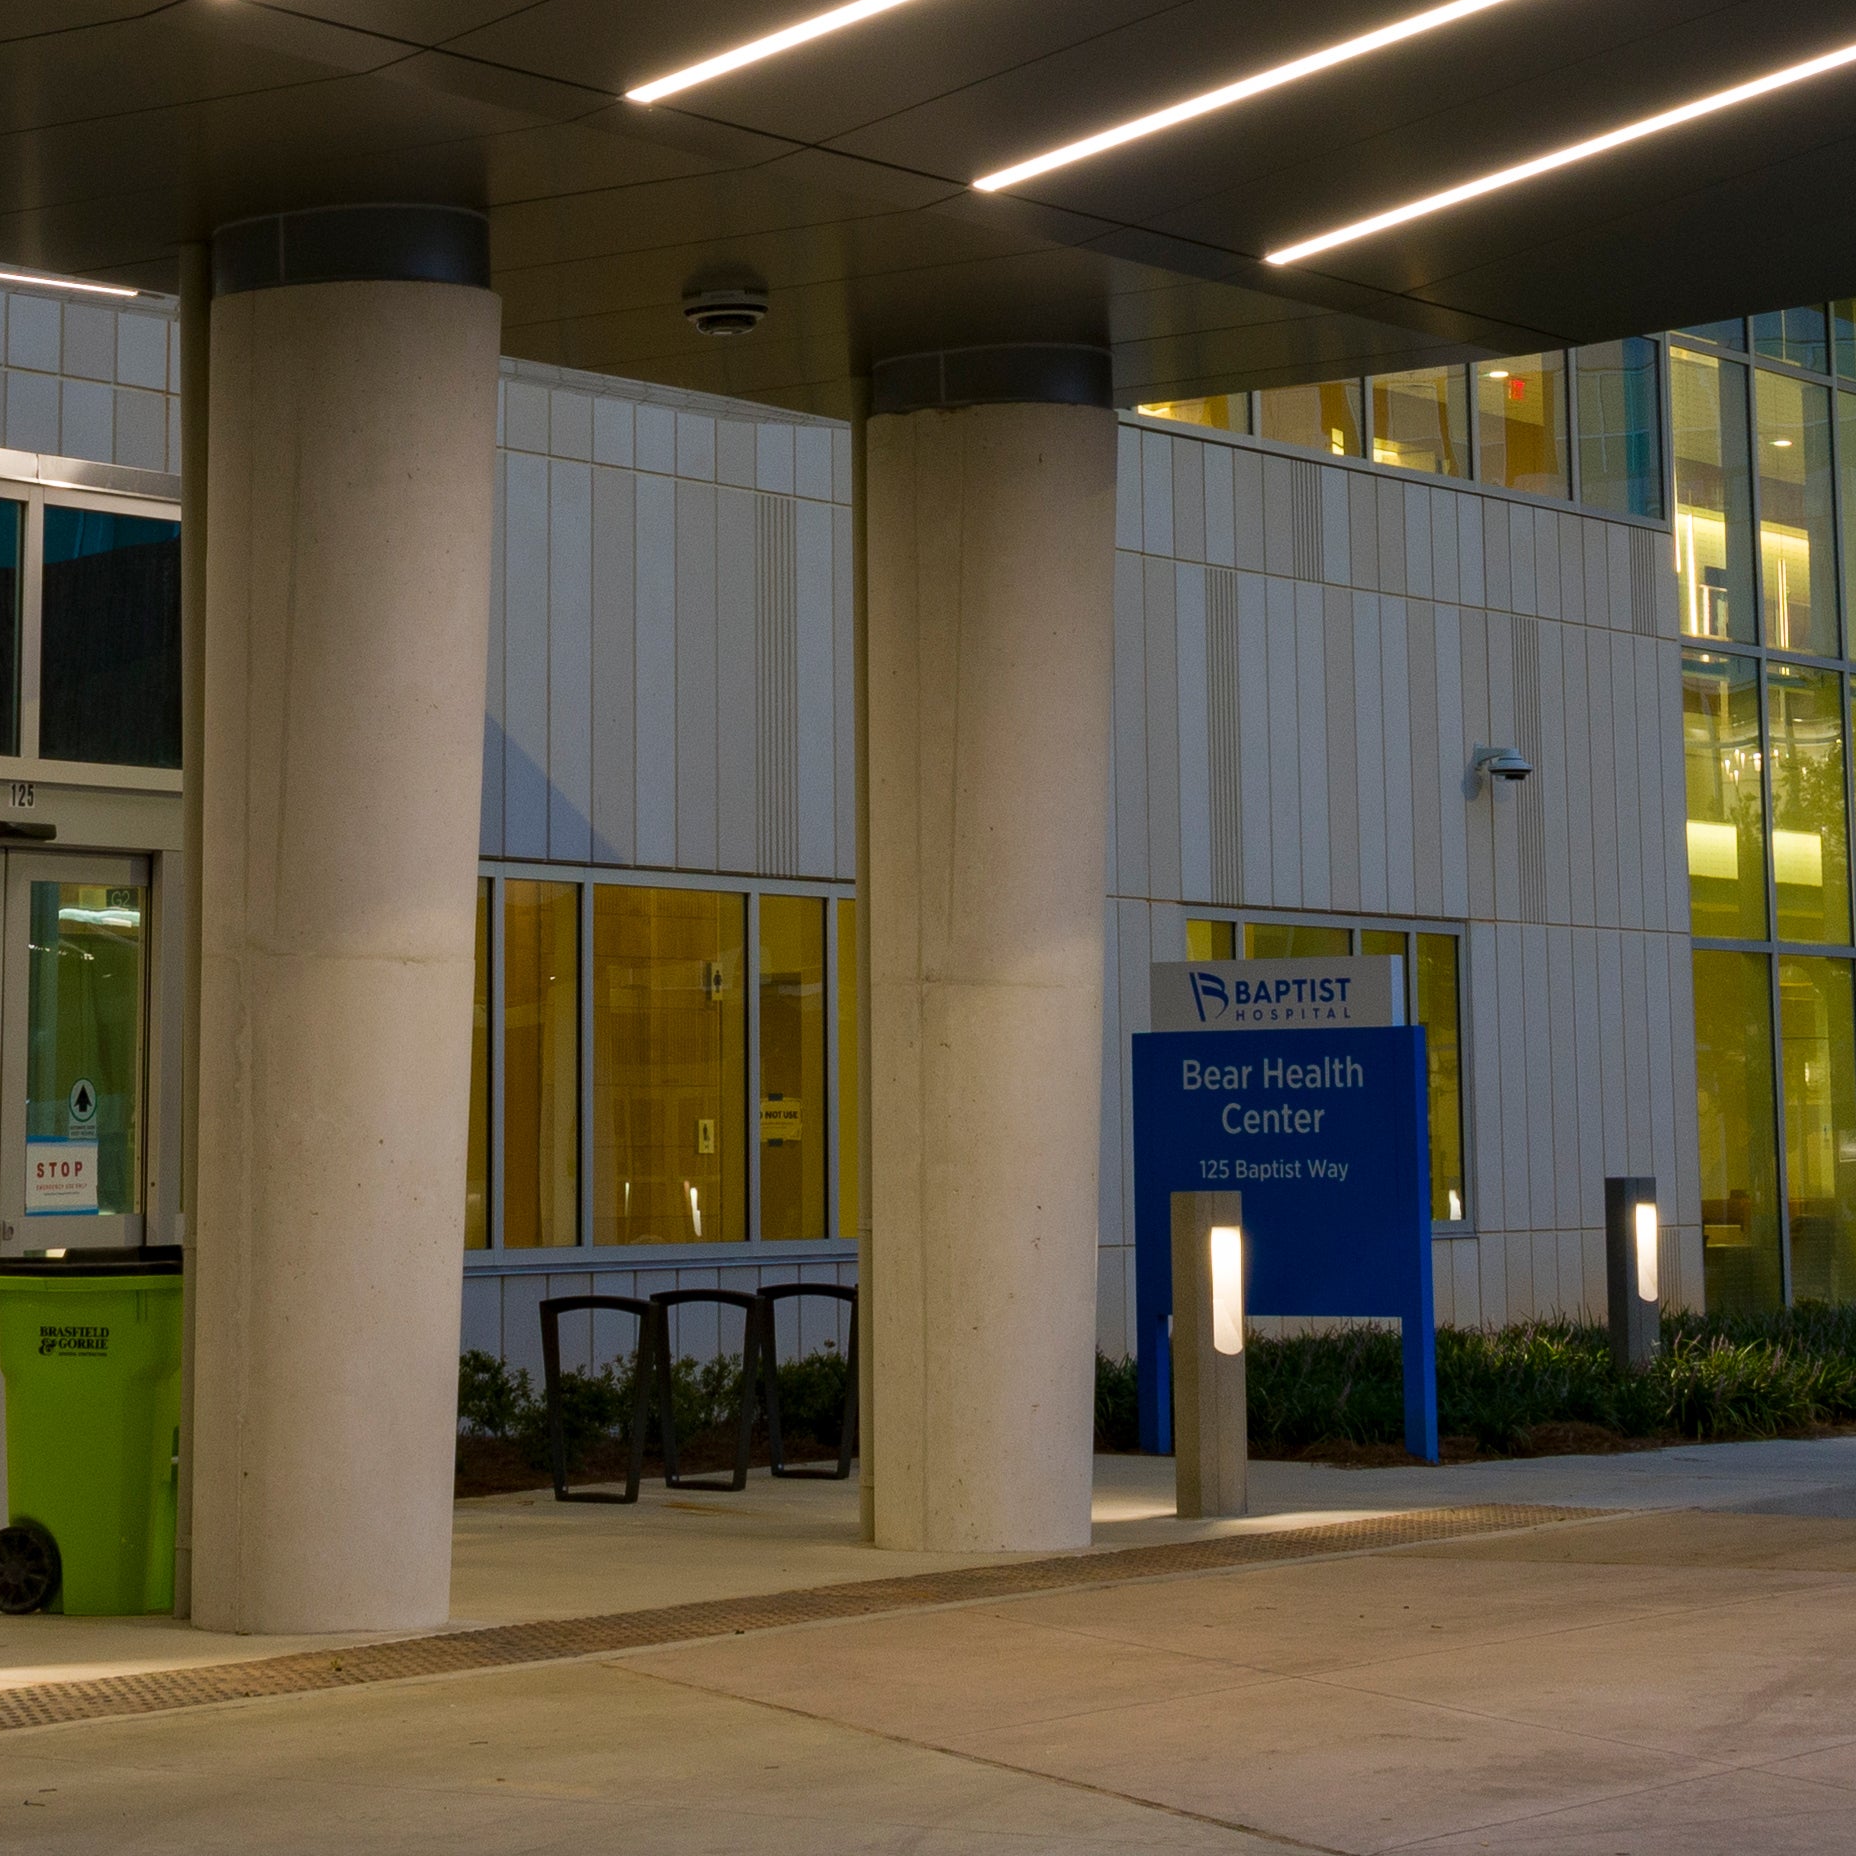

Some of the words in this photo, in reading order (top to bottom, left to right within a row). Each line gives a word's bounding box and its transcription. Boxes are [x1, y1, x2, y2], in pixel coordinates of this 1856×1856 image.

[11, 783, 34, 807] 125
[1235, 977, 1352, 1005] BAPTIST
[1235, 1007, 1352, 1022] HOSPITAL
[1182, 1058, 1253, 1090] Bear
[1262, 1055, 1365, 1089] Health
[1221, 1102, 1326, 1135] Center
[37, 1161, 83, 1178] STOP
[1199, 1159, 1230, 1180] 125
[1235, 1158, 1303, 1183] Baptist
[1307, 1158, 1350, 1183] Way
[39, 1326, 110, 1338] BRASFIELD
[58, 1338, 109, 1350] GORRIE
